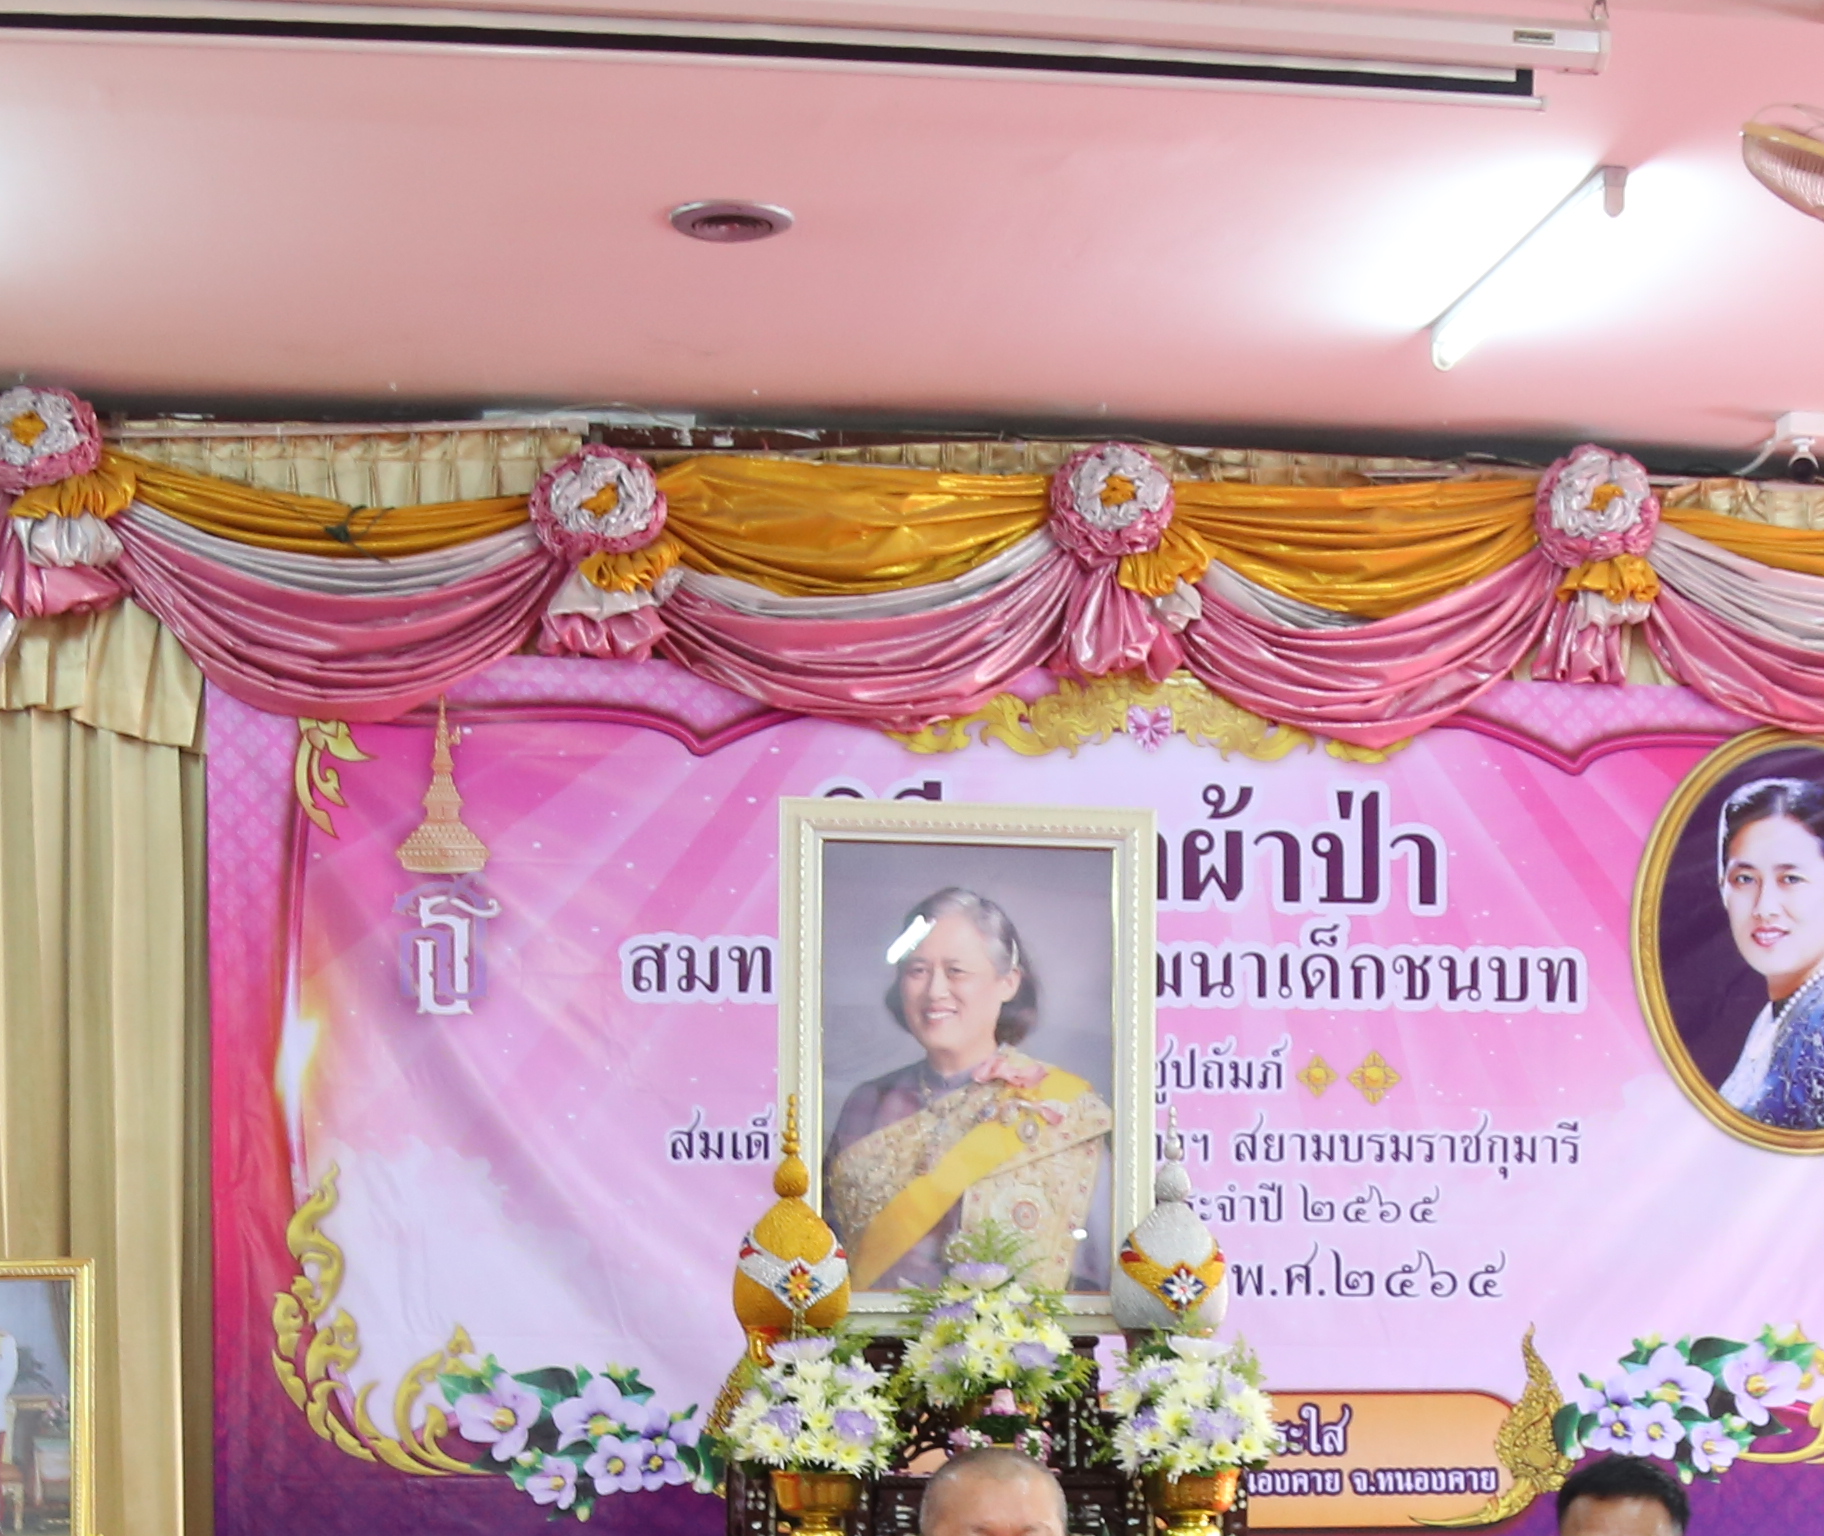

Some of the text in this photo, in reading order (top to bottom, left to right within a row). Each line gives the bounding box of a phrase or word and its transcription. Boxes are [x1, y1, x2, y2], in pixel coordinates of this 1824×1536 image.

[1157, 784, 1436, 905] ผ้าป่า
[670, 1109, 777, 1160] สมเด็
[1234, 1113, 1581, 1179] สยามบรมราชกุมารี
[1303, 1185, 1439, 1223] ๒๕๖๕
[1232, 1242, 1506, 1297] พ.ศ.๒๕๖๕
[1350, 1469, 1497, 1494] จ.หนองคาย
